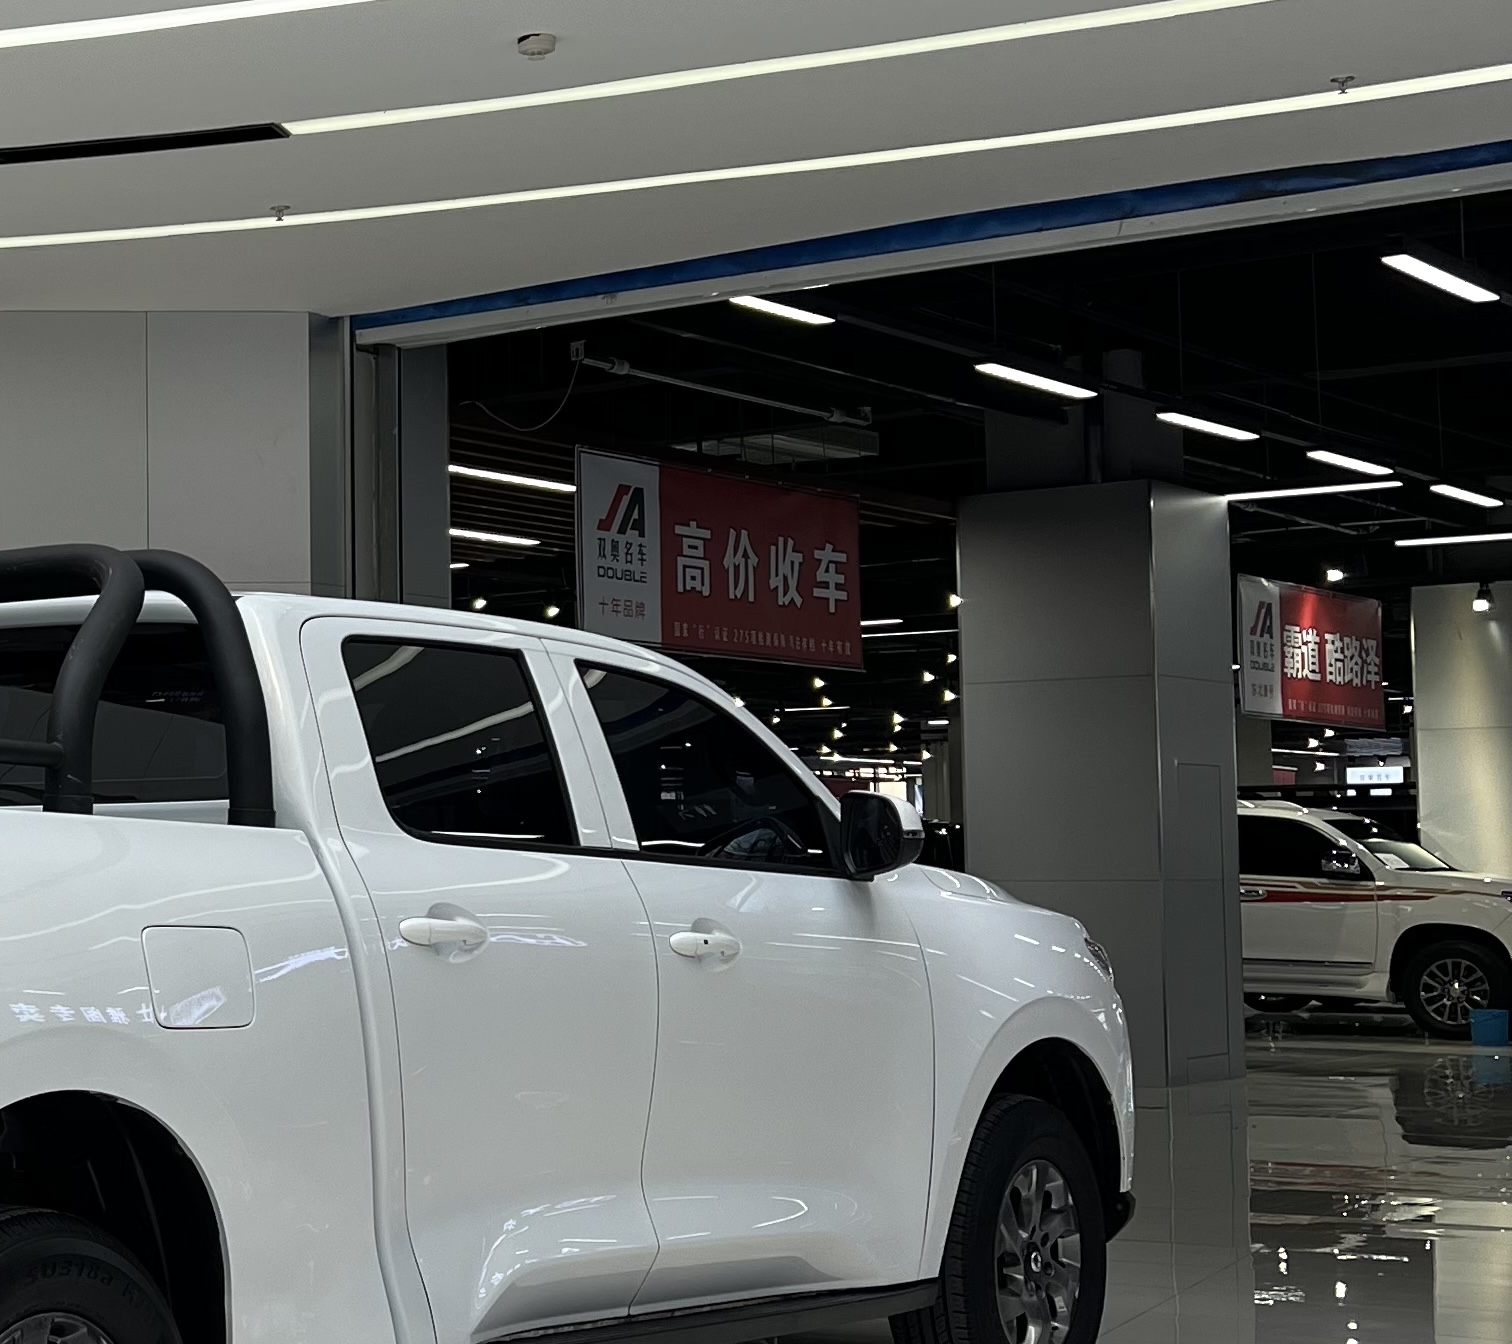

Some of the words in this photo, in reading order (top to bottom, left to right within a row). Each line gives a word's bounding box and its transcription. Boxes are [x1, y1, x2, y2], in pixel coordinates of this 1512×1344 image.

[596, 537, 648, 567] 双奥名车
[673, 519, 850, 615] 高价收车
[596, 565, 648, 584] DOUBLE
[598, 595, 646, 621] 十年品牌
[1283, 623, 1322, 681] 霸道
[1324, 632, 1381, 690] 酷路泽
